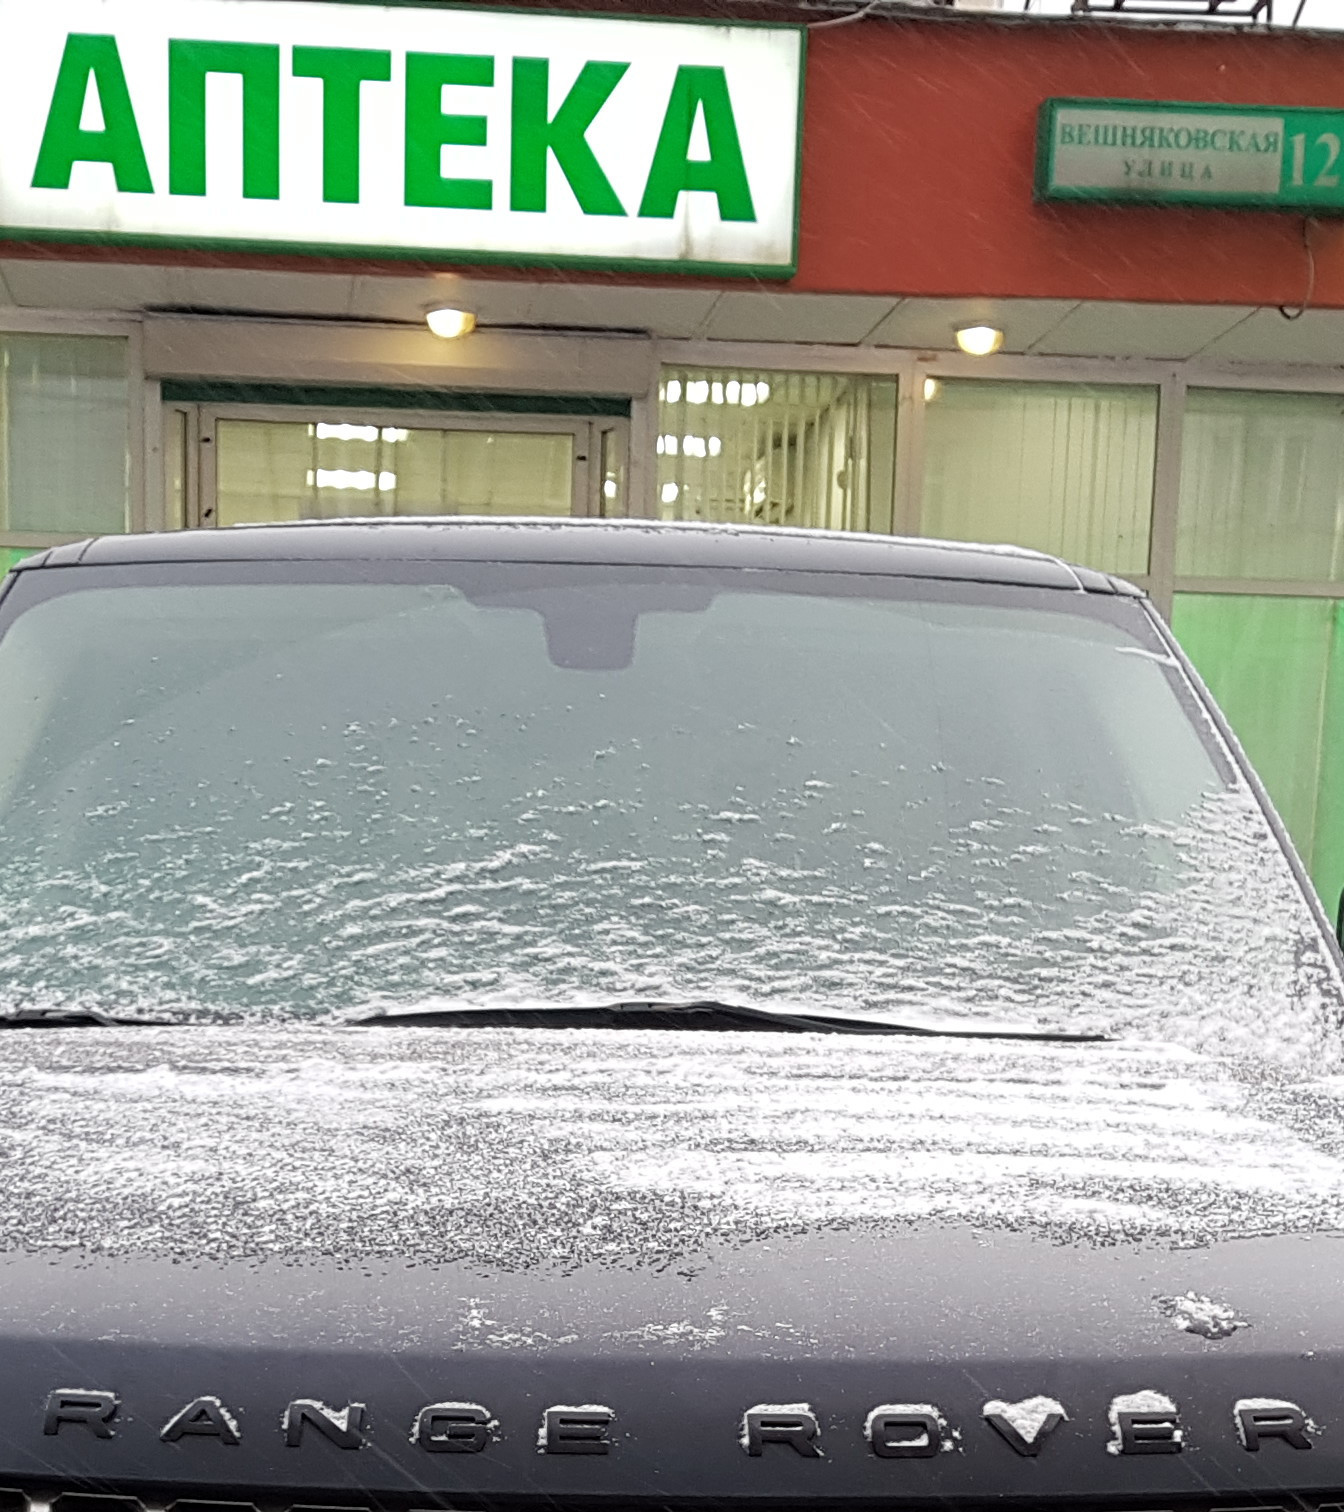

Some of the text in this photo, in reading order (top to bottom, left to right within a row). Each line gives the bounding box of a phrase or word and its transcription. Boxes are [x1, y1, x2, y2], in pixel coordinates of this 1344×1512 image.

[30, 32, 757, 223] АПТЕКА
[1059, 122, 1279, 154] ВЕШНЯКОВСКАЯ
[1122, 159, 1214, 181] УЛИЦА
[1289, 132, 1342, 188] 12
[43, 1388, 1313, 1458] RANGE ROVER
